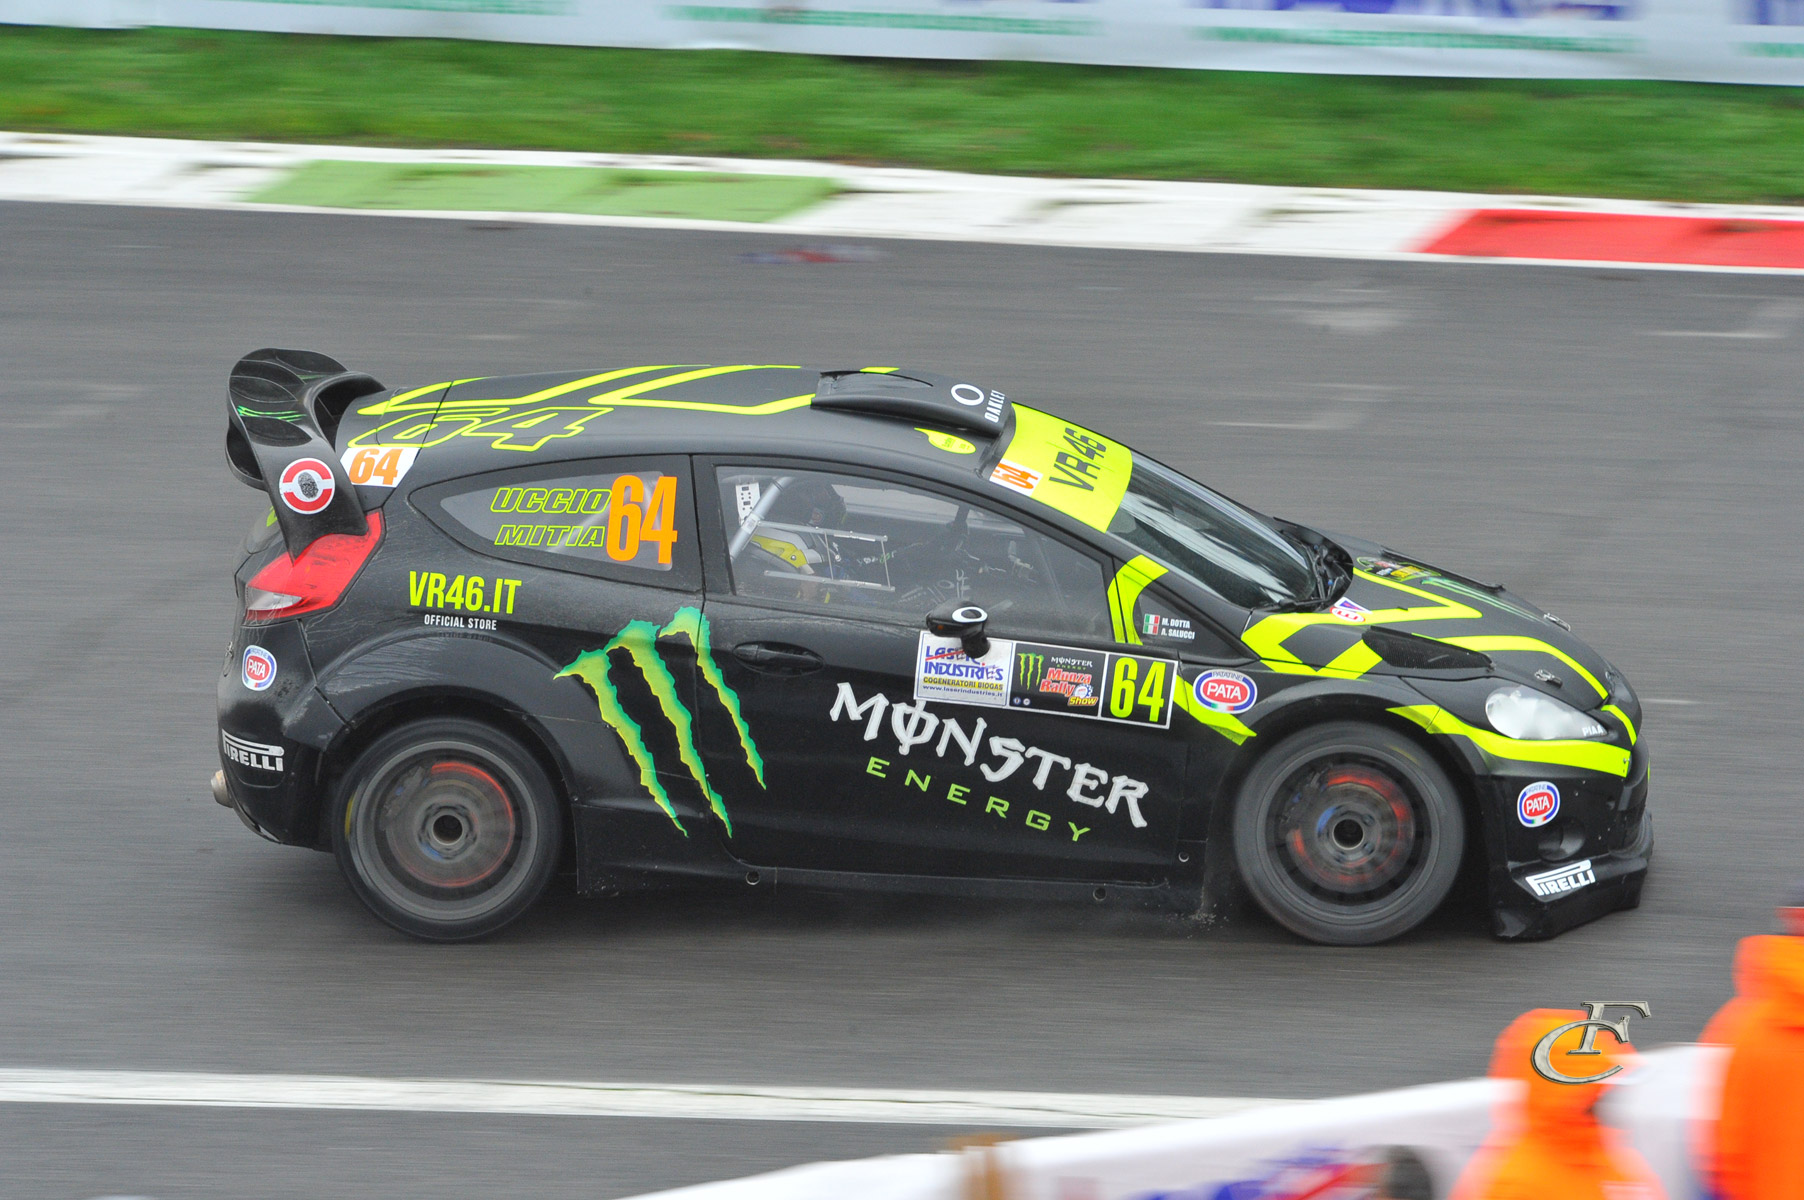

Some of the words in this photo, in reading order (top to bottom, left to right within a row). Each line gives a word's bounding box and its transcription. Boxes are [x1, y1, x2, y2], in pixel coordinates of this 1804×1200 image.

[348, 406, 614, 452] 64
[349, 448, 403, 485] 64
[1048, 427, 1107, 492] VR46
[490, 487, 613, 514] UCCIO
[606, 474, 678, 564] 64
[494, 524, 606, 547] MITIA
[409, 570, 523, 615] VR46.IT
[424, 614, 465, 628] OFFICIAL
[467, 617, 498, 631] STORE
[1161, 617, 1170, 627] M.
[1170, 619, 1191, 629] DOTTA
[1161, 627, 1167, 636] A.
[1168, 628, 1196, 640] SALUCCI
[247, 659, 266, 678] PATA
[1212, 671, 1244, 682] PATATINE
[922, 685, 1003, 697] www.laserindustries.it
[923, 676, 976, 688] COGENERATORI
[977, 682, 1004, 691] BIOGAS
[1039, 679, 1076, 698] Rally
[1110, 657, 1166, 722] 64
[1207, 682, 1242, 700] PATA
[1067, 696, 1099, 706] Show
[1582, 725, 1604, 737] PIAA
[222, 728, 285, 772] PIRELLI
[866, 756, 1091, 842] ENERGY
[1526, 797, 1551, 815] PATA
[1525, 859, 1596, 897] PIRELLI
